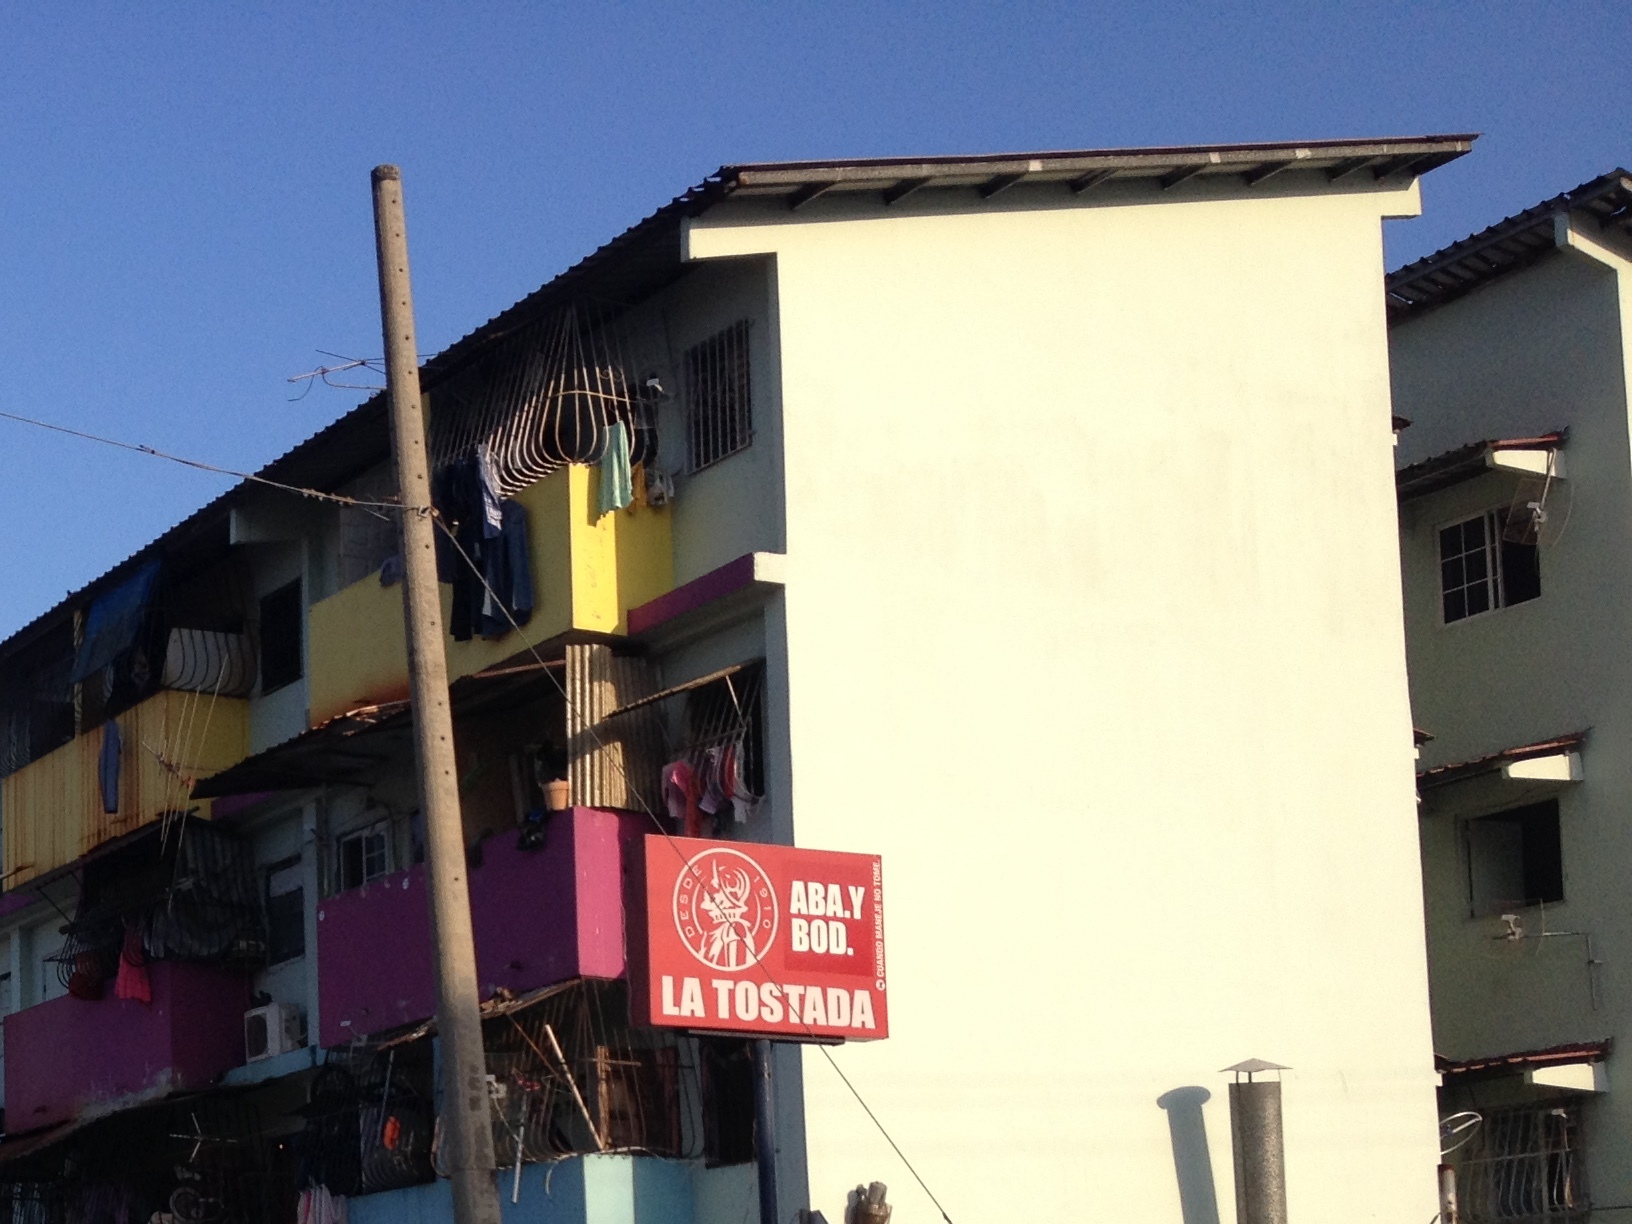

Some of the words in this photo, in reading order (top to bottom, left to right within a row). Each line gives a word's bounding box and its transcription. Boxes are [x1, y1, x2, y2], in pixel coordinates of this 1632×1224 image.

[679, 864, 702, 938] DESDE
[873, 888, 881, 901] NO
[791, 917, 854, 956] BOD.
[661, 975, 706, 1018] LA
[712, 978, 876, 1029] TOSTADA
